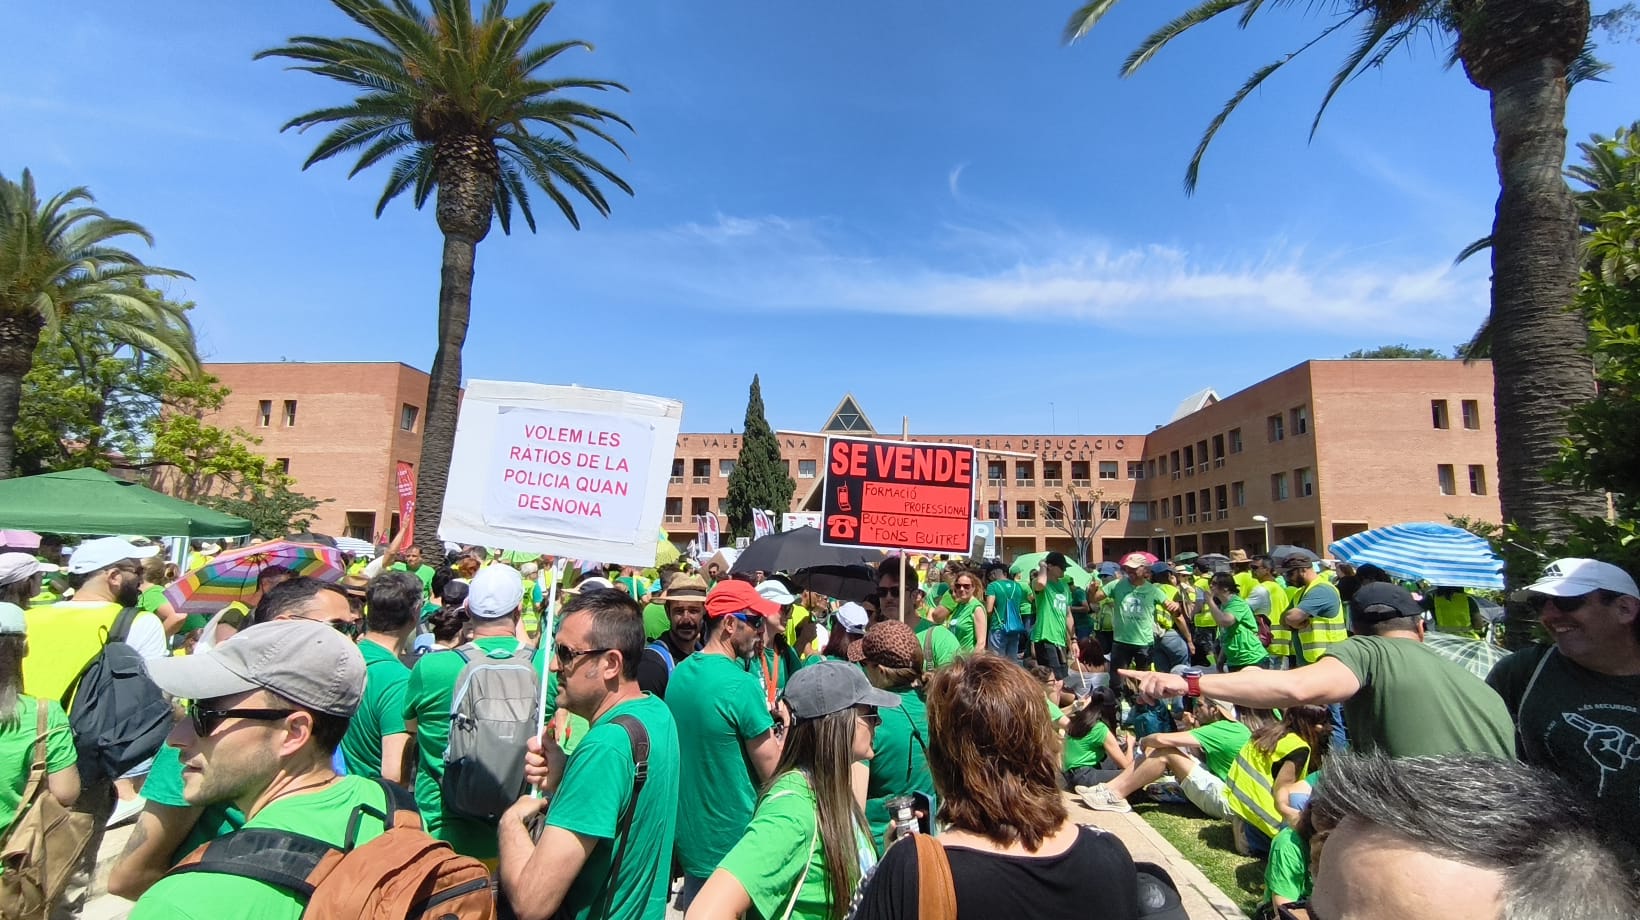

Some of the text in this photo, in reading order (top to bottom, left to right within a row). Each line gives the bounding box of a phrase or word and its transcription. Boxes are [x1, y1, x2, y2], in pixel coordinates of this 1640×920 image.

[525, 424, 621, 447] VOLEM LES
[576, 453, 601, 469] DE
[605, 456, 629, 473] LA
[831, 441, 971, 484] SE VENDE
[503, 468, 628, 497] POLICIA QUAN
[865, 482, 917, 500] FORMACIÓ
[518, 493, 602, 518] DESNONA
[862, 513, 919, 527] BUSQUEM
